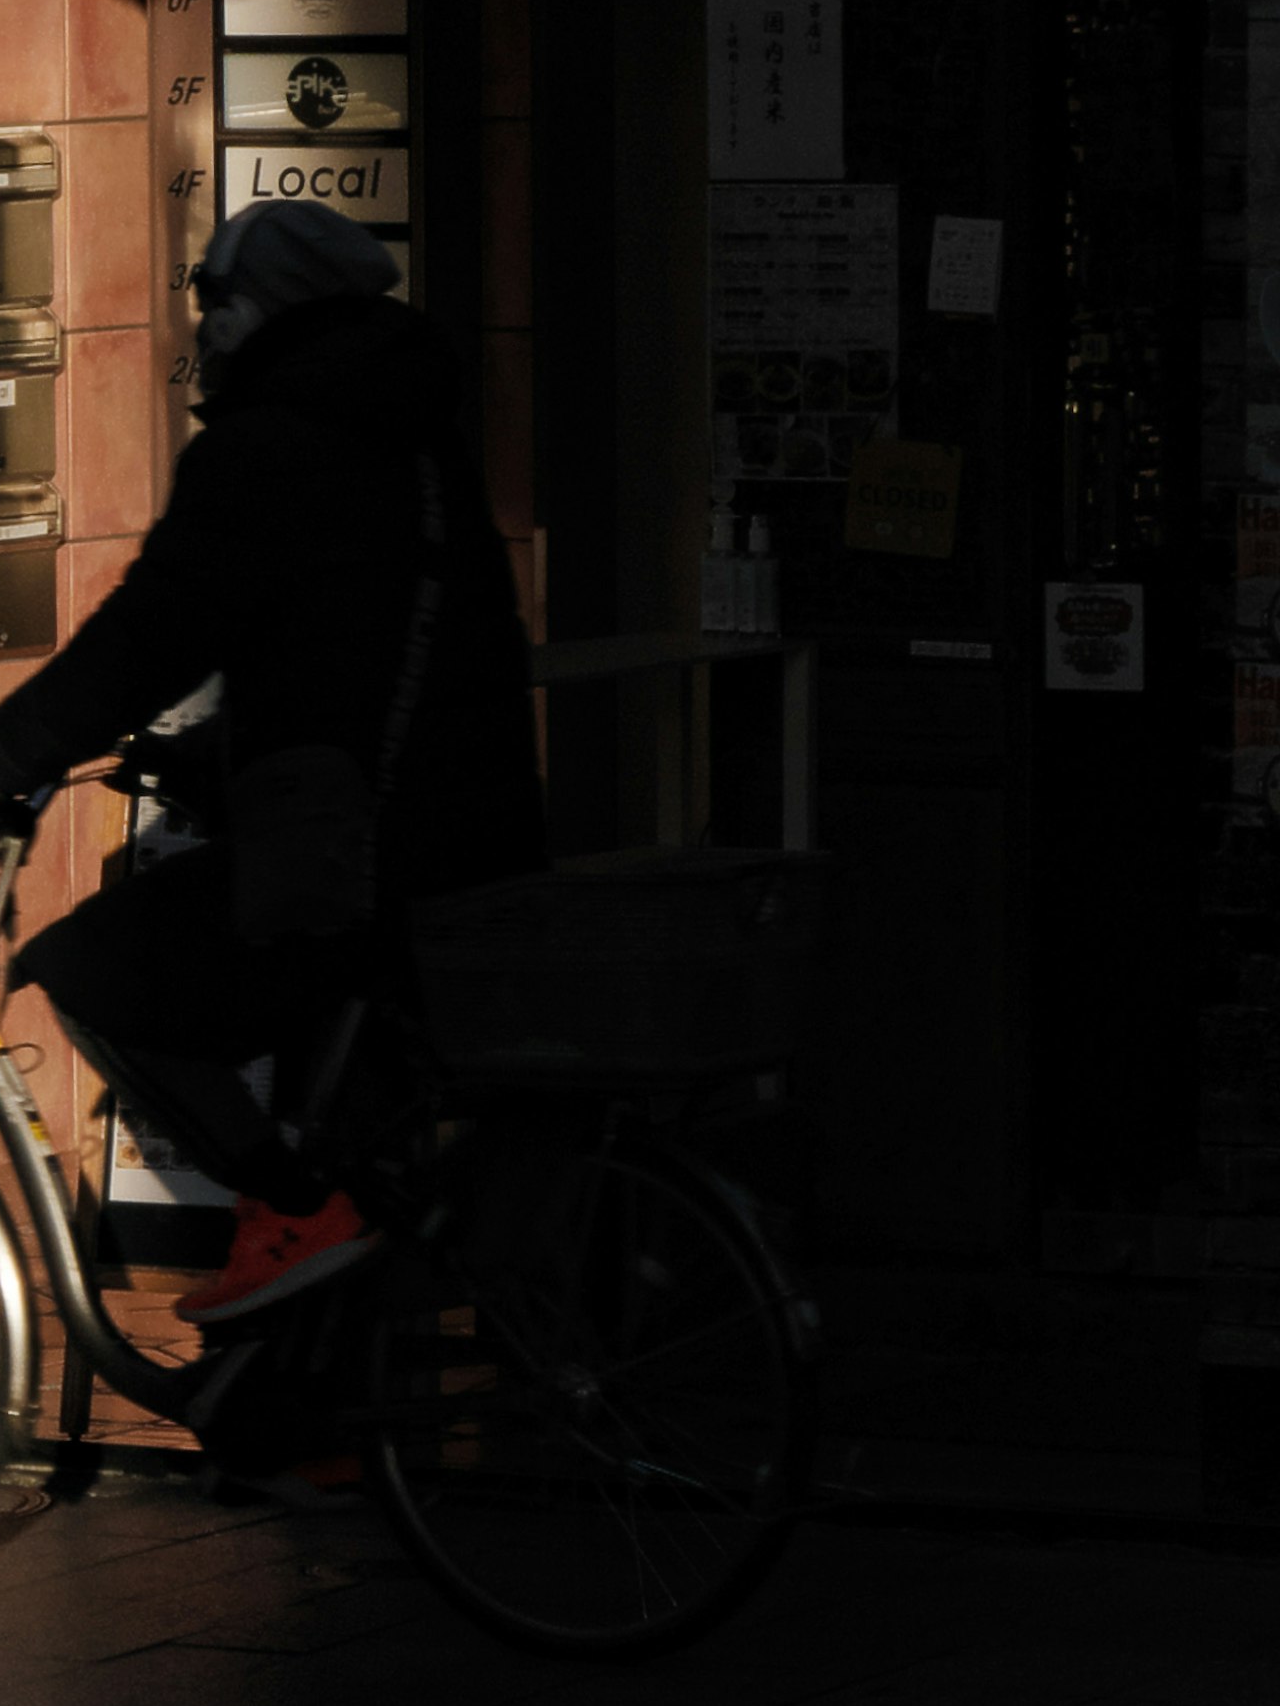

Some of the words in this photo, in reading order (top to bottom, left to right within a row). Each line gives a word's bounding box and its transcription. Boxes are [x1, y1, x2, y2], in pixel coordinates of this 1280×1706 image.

[168, 77, 205, 106] 5F
[168, 169, 206, 199] 4F
[251, 156, 382, 199] Local
[858, 483, 948, 511] CLOSED
